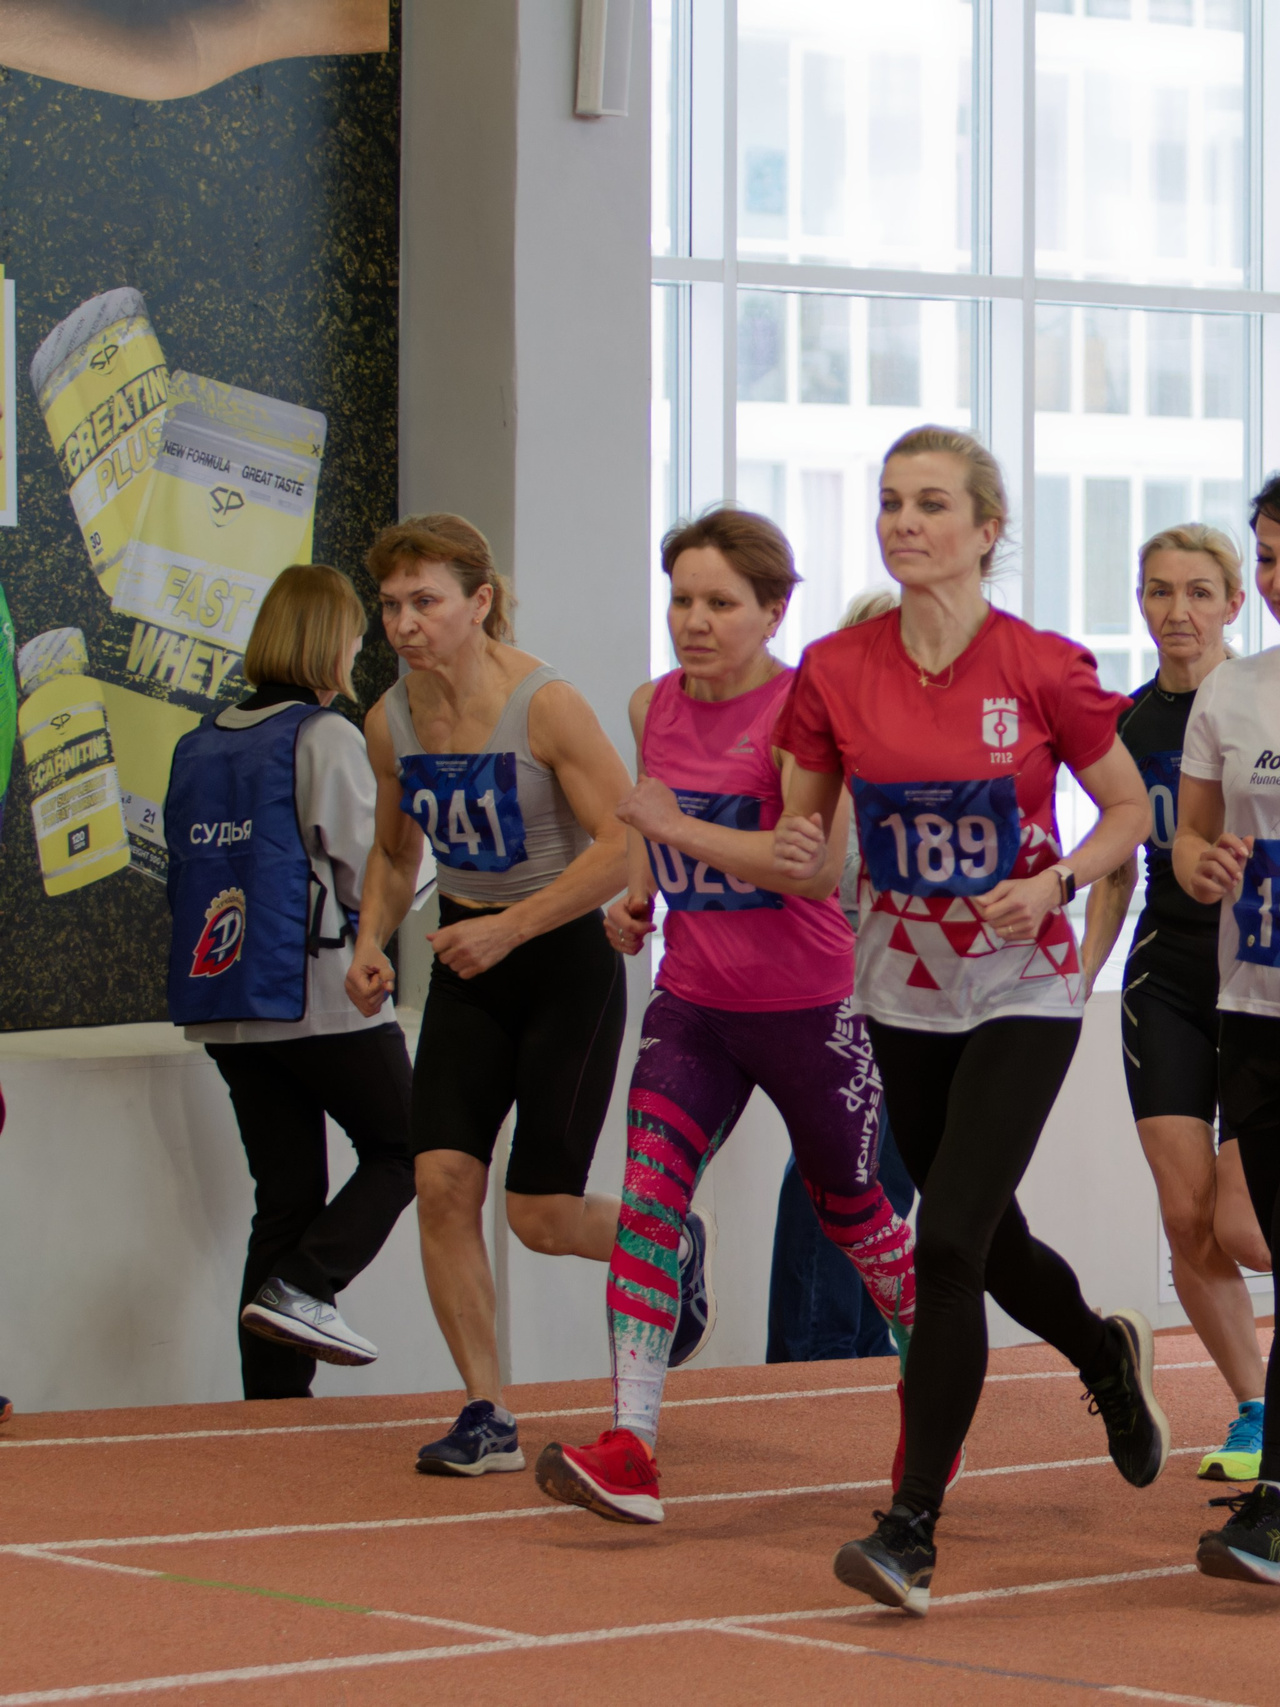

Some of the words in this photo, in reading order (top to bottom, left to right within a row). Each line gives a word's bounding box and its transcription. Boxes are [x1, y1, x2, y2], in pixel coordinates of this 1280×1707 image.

[65, 366, 169, 479] CREATIN
[95, 418, 162, 505] PLUS
[162, 439, 186, 459] NEW
[186, 448, 231, 474] FORMULA
[241, 465, 274, 487] GREAT
[274, 475, 305, 497] TASTE
[156, 564, 255, 634] FAST
[126, 621, 242, 701] WHEY
[989, 751, 1014, 764] 1712
[143, 808, 156, 825] 21
[190, 819, 253, 847] СУДЬЯ
[412, 788, 507, 857] 241
[879, 812, 999, 883] 189
